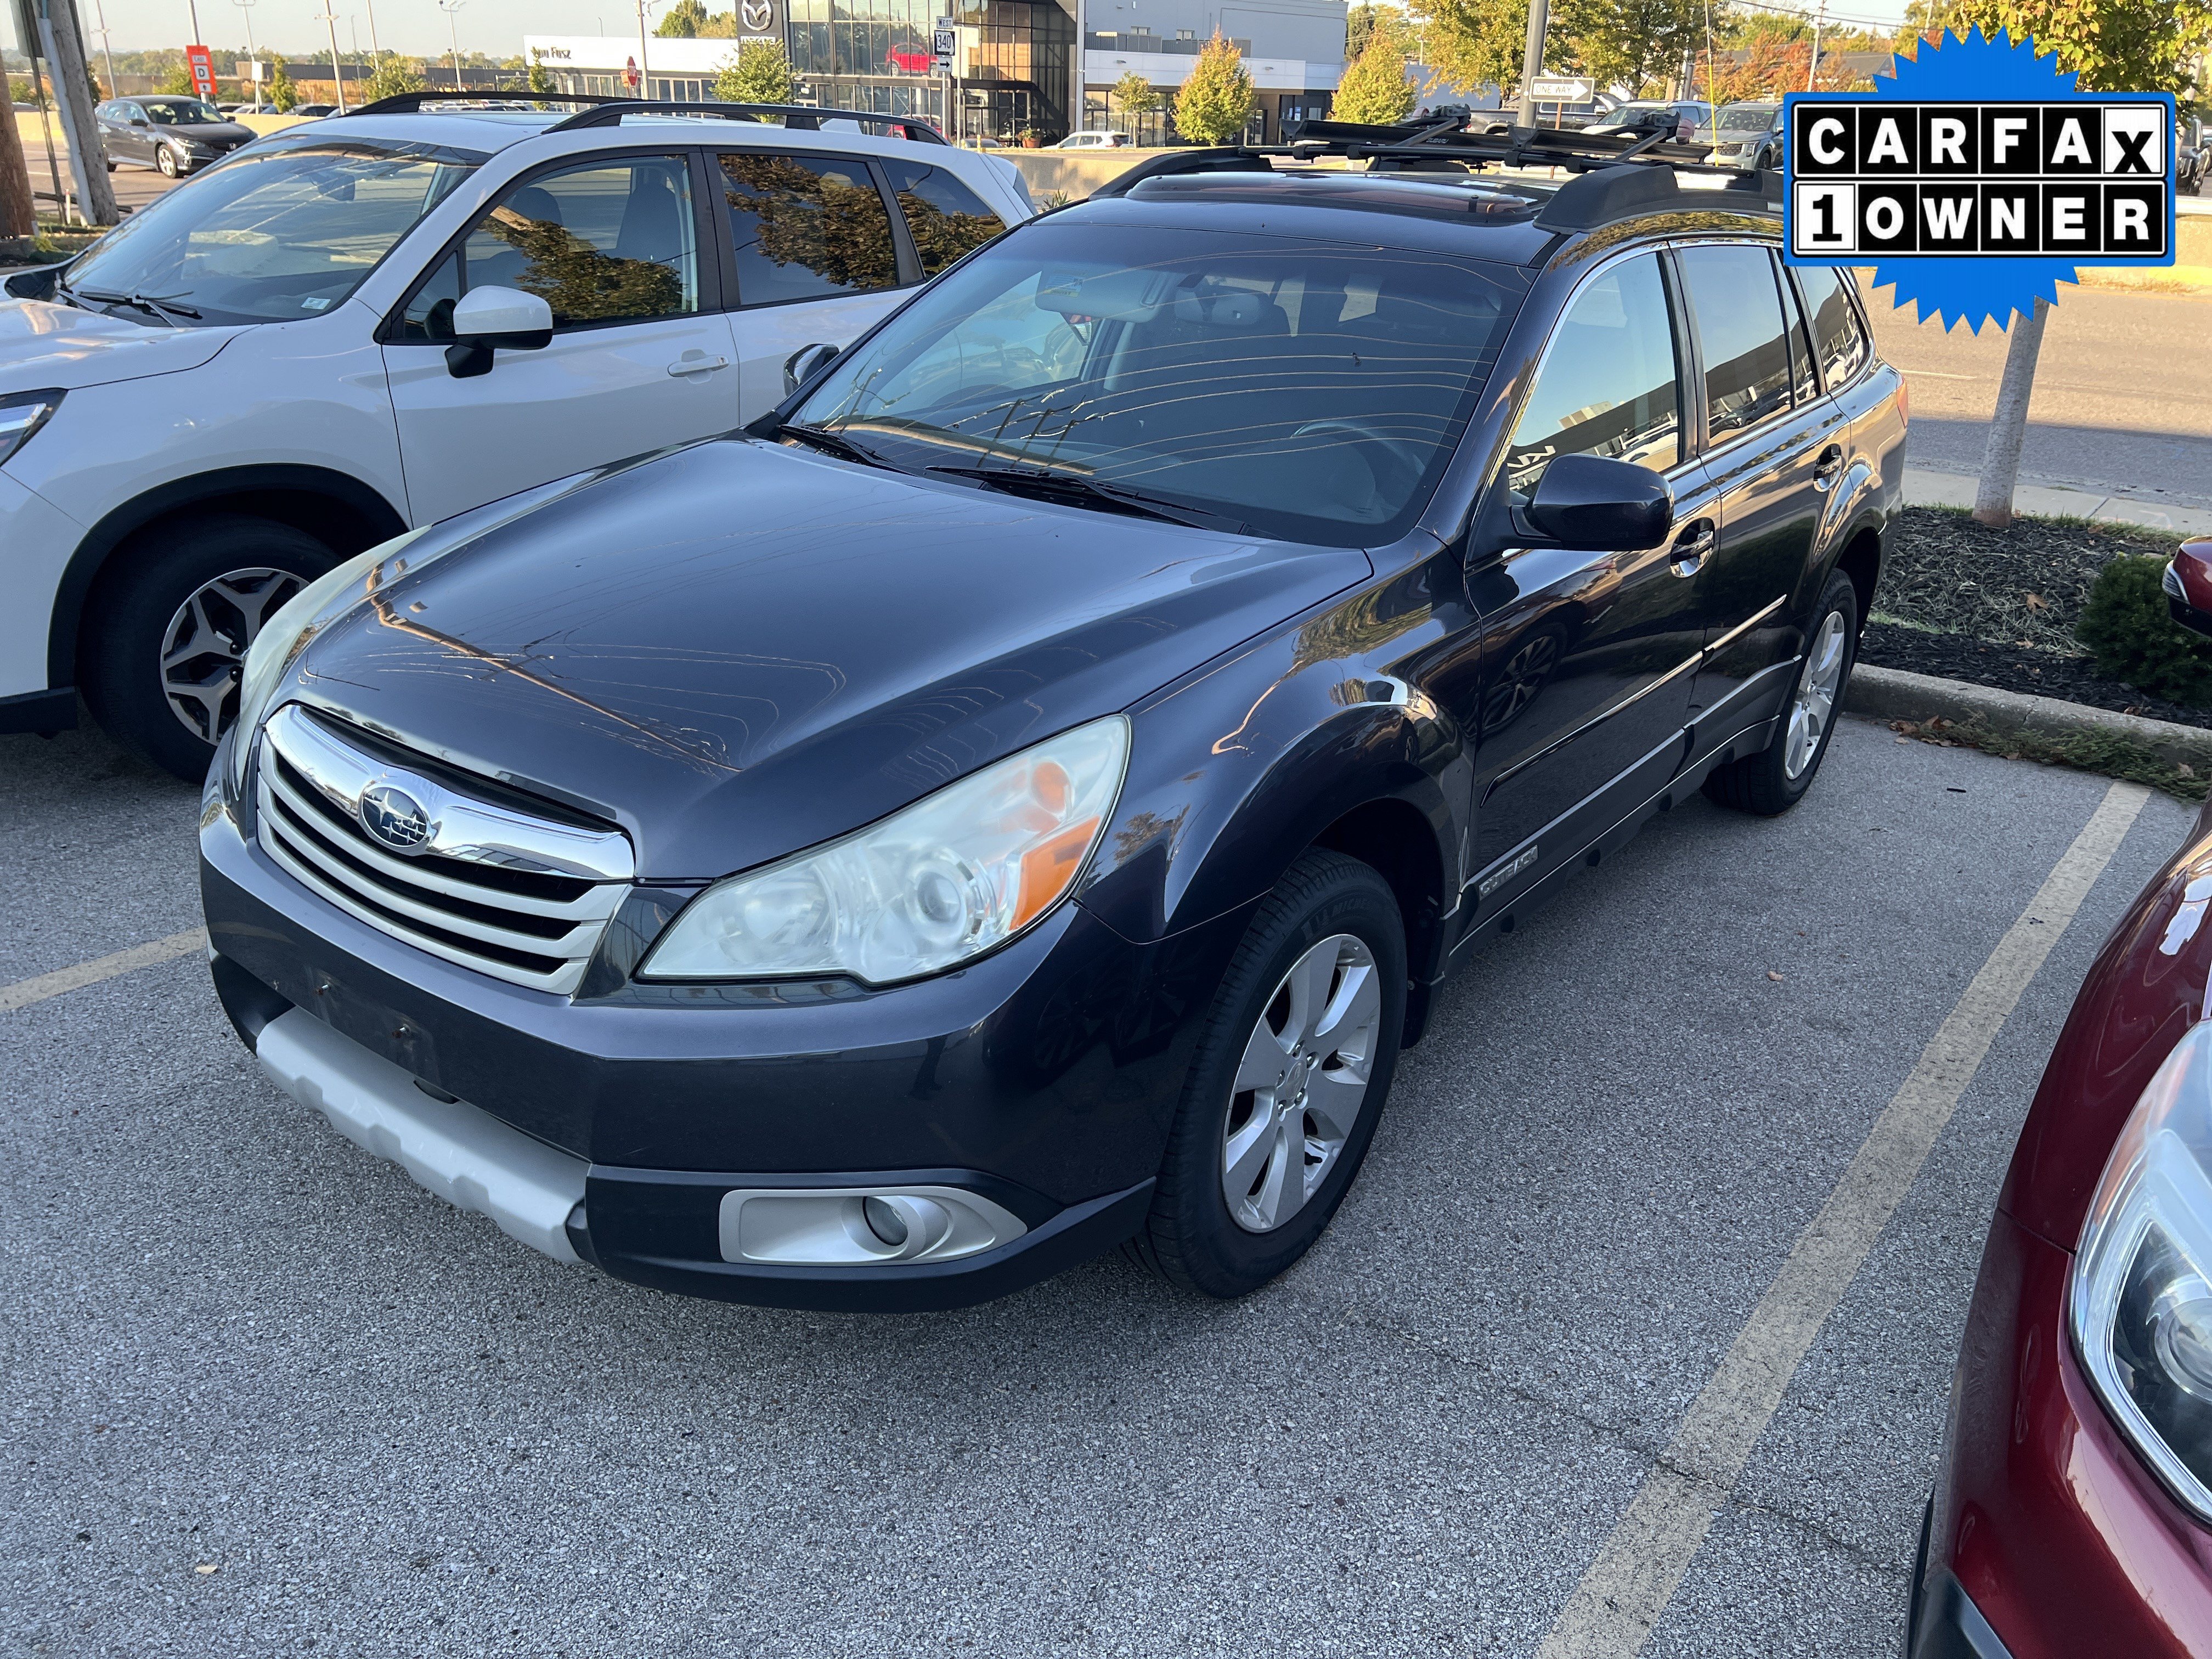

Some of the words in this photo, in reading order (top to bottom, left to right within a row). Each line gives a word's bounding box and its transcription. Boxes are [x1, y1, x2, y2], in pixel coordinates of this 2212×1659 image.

[938, 18, 952, 27] WEST
[938, 35, 951, 49] 340
[198, 67, 205, 77] D
[1536, 85, 1552, 94] ONE
[1556, 86, 1572, 94] WAY
